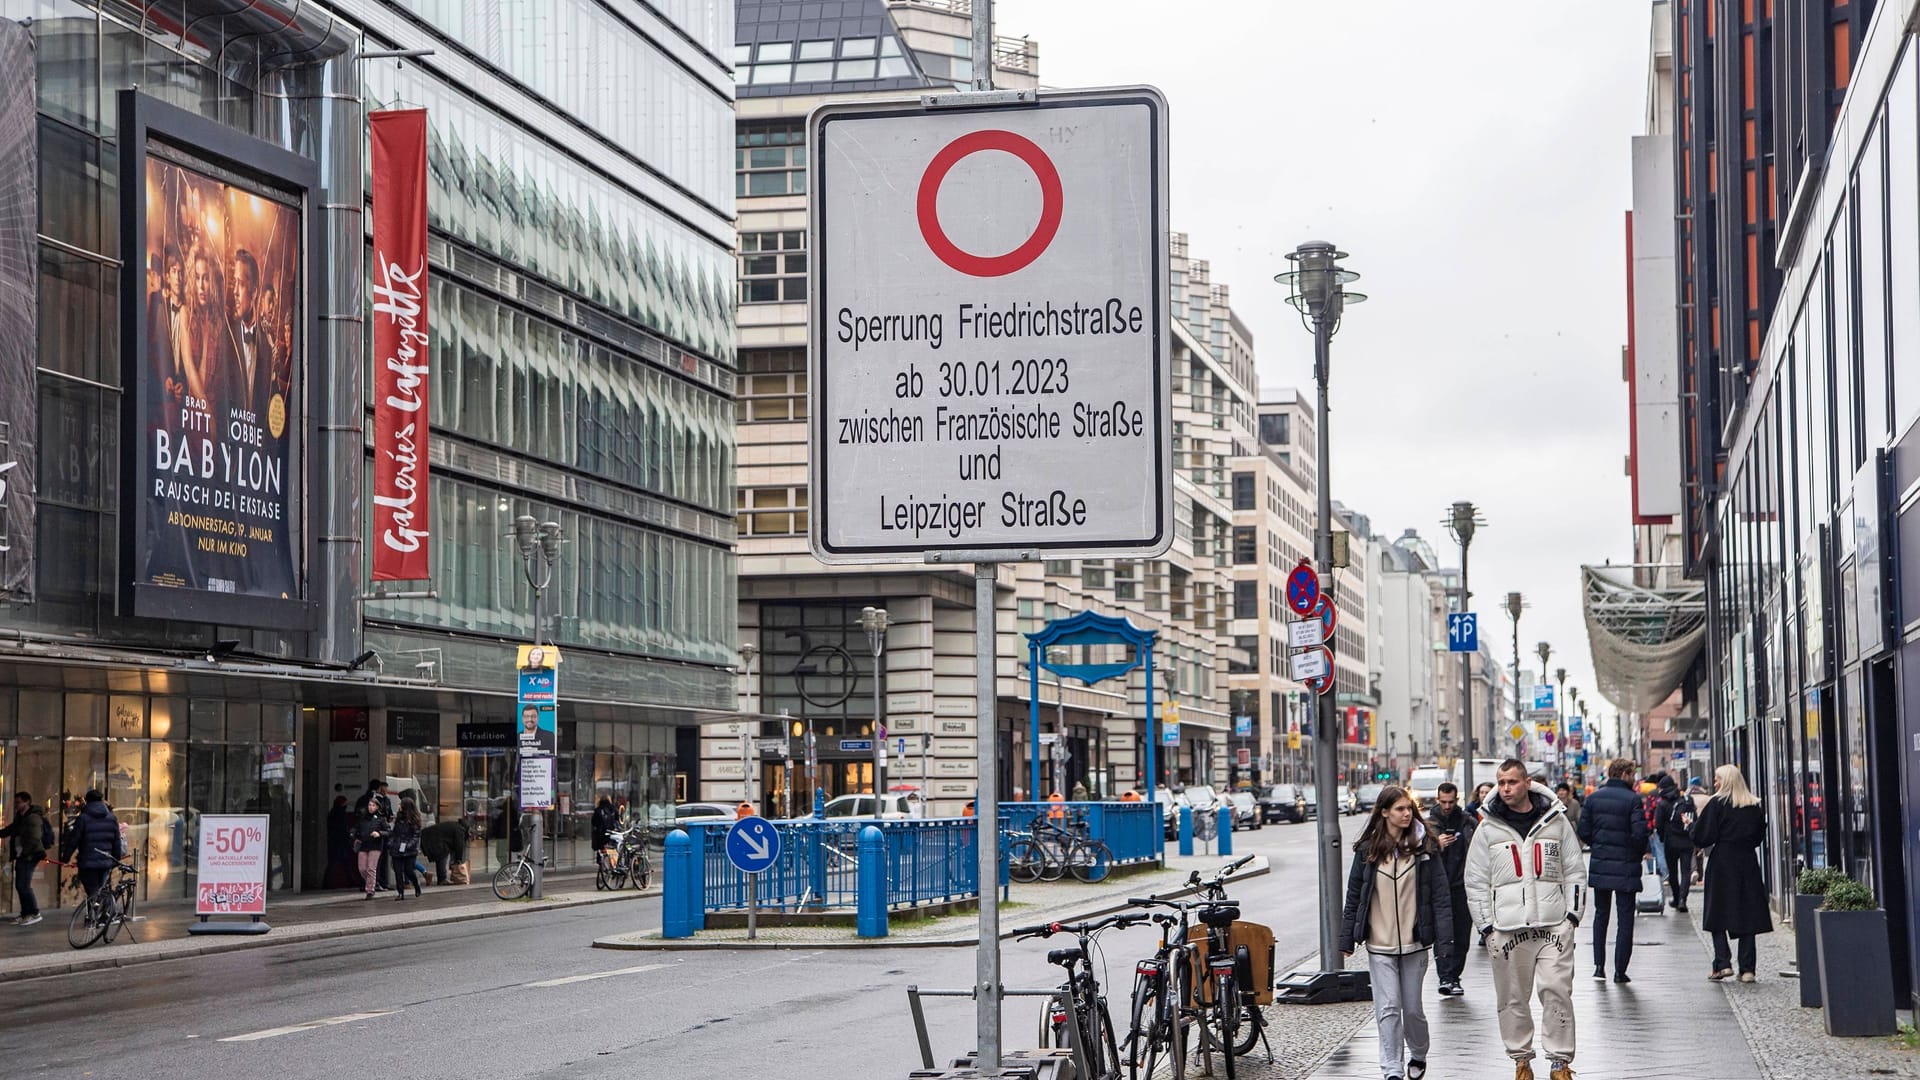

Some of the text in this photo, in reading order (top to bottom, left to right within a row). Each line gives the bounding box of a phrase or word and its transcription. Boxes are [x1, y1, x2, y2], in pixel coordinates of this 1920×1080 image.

[837, 298, 1143, 351] Sperrung Friedrichstraße
[896, 358, 1069, 398] ab 30.01.2023
[185, 396, 207, 410] BRAD
[374, 250, 429, 552] Galeries Lafayette
[181, 409, 211, 433] PITT
[227, 419, 263, 447] OBBIE
[838, 400, 1143, 444] zwischen Französische Straße
[156, 428, 281, 495] BABYLON
[959, 445, 1001, 481] und
[155, 478, 210, 507] RAUSCH
[240, 495, 281, 520] EKSTASE
[881, 490, 1087, 539] Leipziger Straße
[198, 537, 247, 558] NUR IM KINO
[1463, 622, 1473, 643] P
[353, 727, 367, 740] 76
[461, 731, 506, 740] &Tradition
